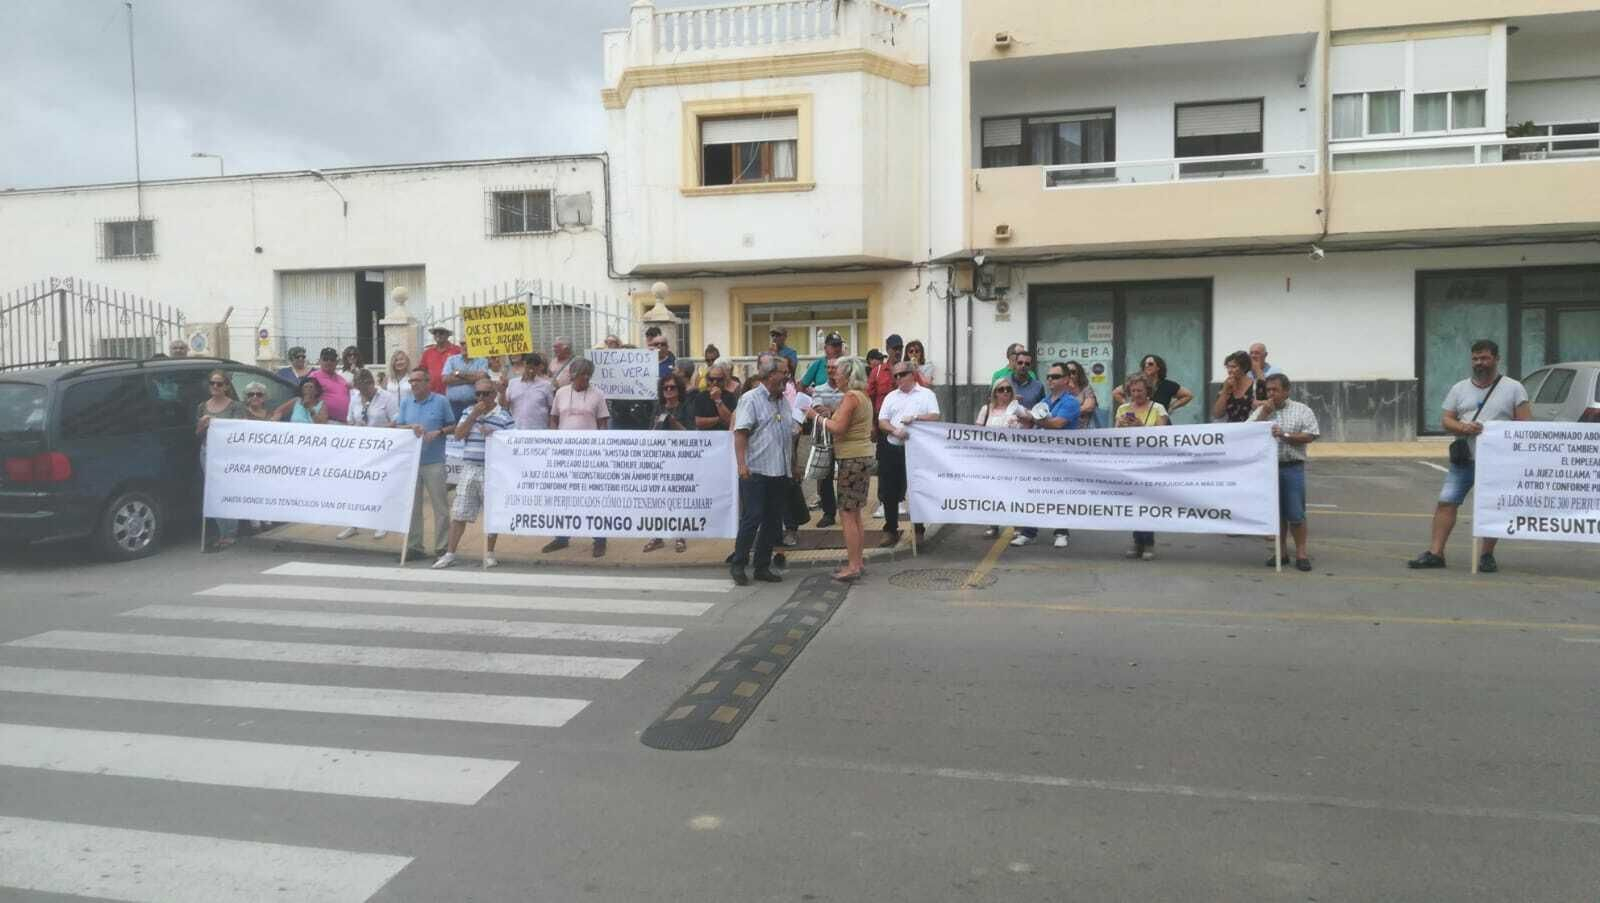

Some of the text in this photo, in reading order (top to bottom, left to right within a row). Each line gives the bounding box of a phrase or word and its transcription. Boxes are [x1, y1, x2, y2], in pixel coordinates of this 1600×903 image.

[492, 303, 527, 317] FALSAS
[482, 324, 492, 335] SE
[493, 321, 525, 332] TRAGAN
[484, 336, 494, 346] EL
[504, 342, 529, 354] VERA
[1037, 346, 1110, 358] COCHERA
[602, 366, 650, 378] DE VERA
[946, 428, 1225, 448] JUSTICIA INDEPENDIENTE POR FAVOR
[1504, 430, 1512, 439] EL
[1514, 430, 1582, 440] AUTODENOMINADO
[227, 431, 394, 452] ¿LA FISCALÍA PARA QUE ESTÁ?
[606, 438, 638, 446] COMUNIDAD
[640, 438, 646, 446] LO
[648, 438, 666, 447] LLAMA
[704, 439, 712, 448] LA
[590, 460, 609, 468] LLAMA
[1562, 456, 1569, 466] EL
[253, 464, 307, 477] PROMOVER
[309, 467, 320, 477] LA
[322, 468, 388, 482] LEGALIDAD?
[550, 471, 568, 479] LLAMA
[621, 472, 631, 480] SIN
[652, 472, 659, 480] DE
[660, 473, 694, 482] PERJUDICAR
[1524, 468, 1534, 477] LA
[1536, 468, 1554, 478] JUEZ
[1555, 470, 1564, 478] LO
[1566, 470, 1590, 478] LLAMA
[1524, 481, 1544, 490] OTRO
[1552, 482, 1590, 492] CONFORME
[1507, 494, 1524, 507] LOS
[1544, 496, 1556, 508] DE
[940, 498, 1232, 520] JUSTICIA INDEPENDIENTE POR FAVOR
[510, 514, 706, 532] ¿PRESUNTO TONGO JUDICIAL?
